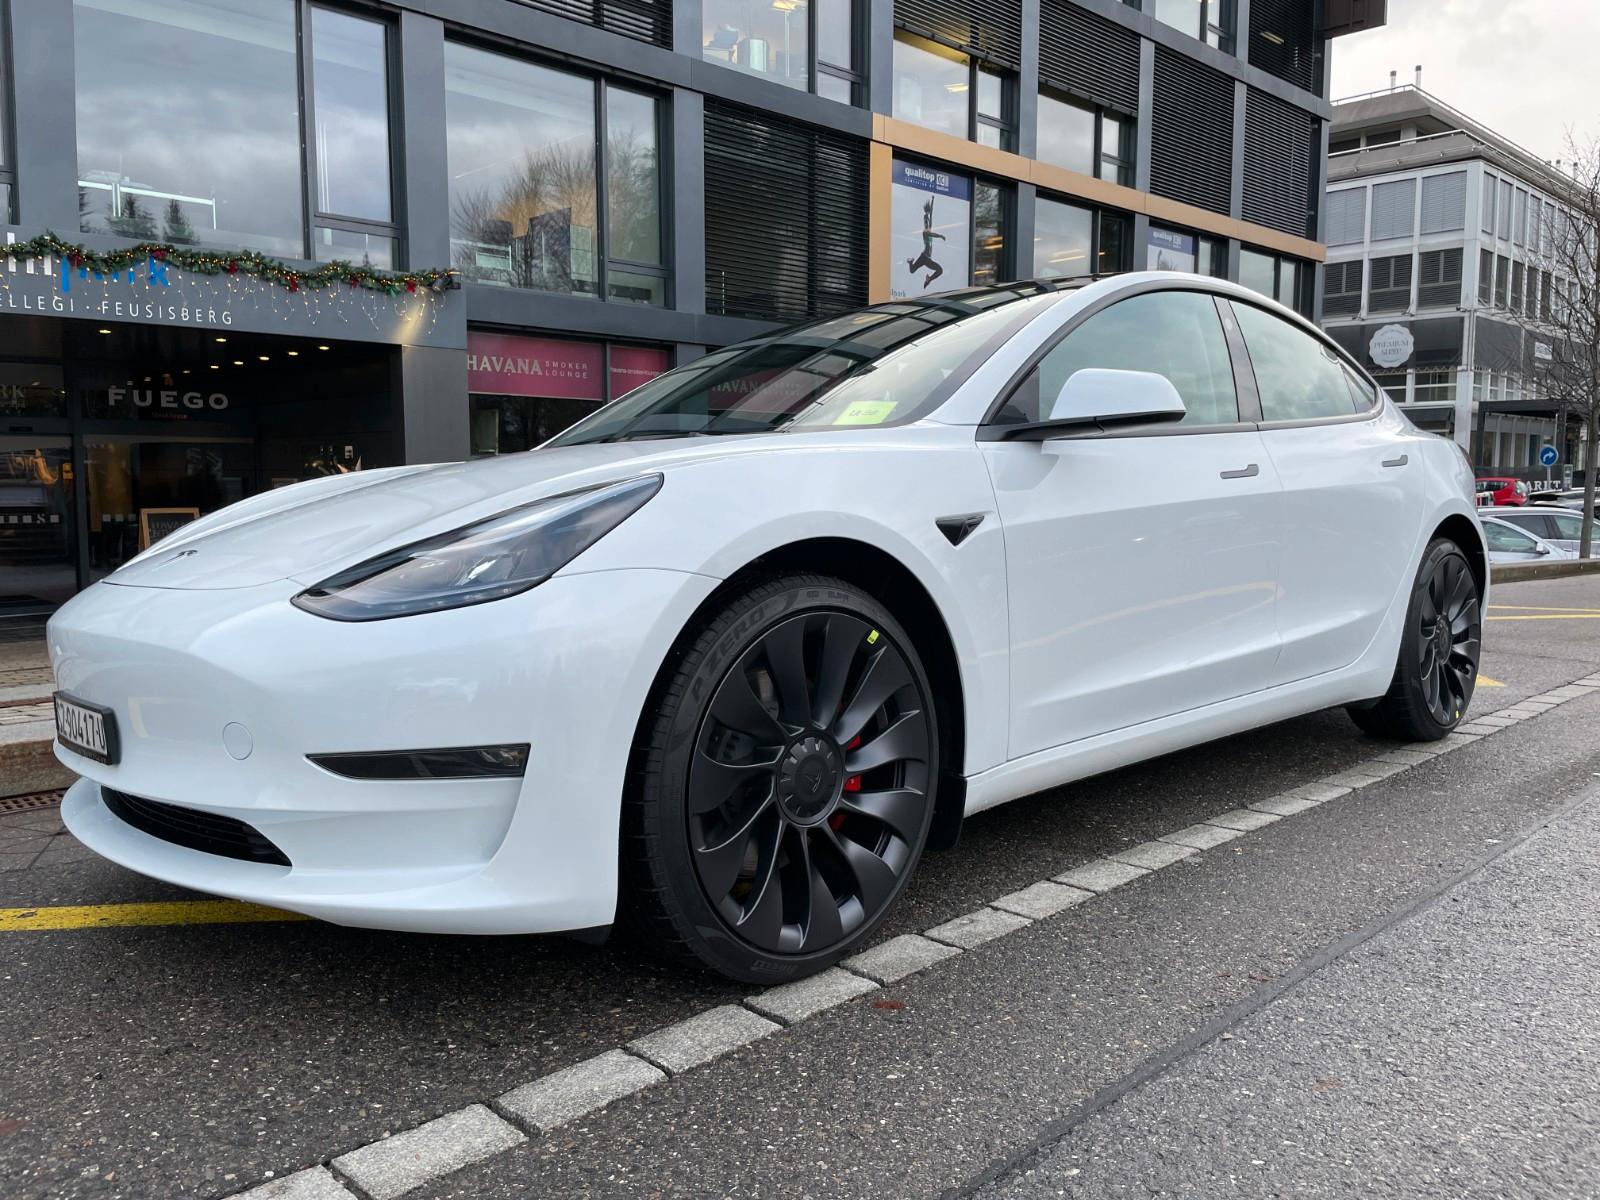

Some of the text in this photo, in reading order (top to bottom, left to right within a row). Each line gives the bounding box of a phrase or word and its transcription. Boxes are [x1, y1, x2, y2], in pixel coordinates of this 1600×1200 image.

[904, 167, 935, 182] qualitop
[102, 300, 233, 325] FEUSISBERG
[467, 354, 588, 376] HAVANA SMOKER
[545, 369, 588, 380] LOUNGE
[108, 388, 229, 410] FUEGO
